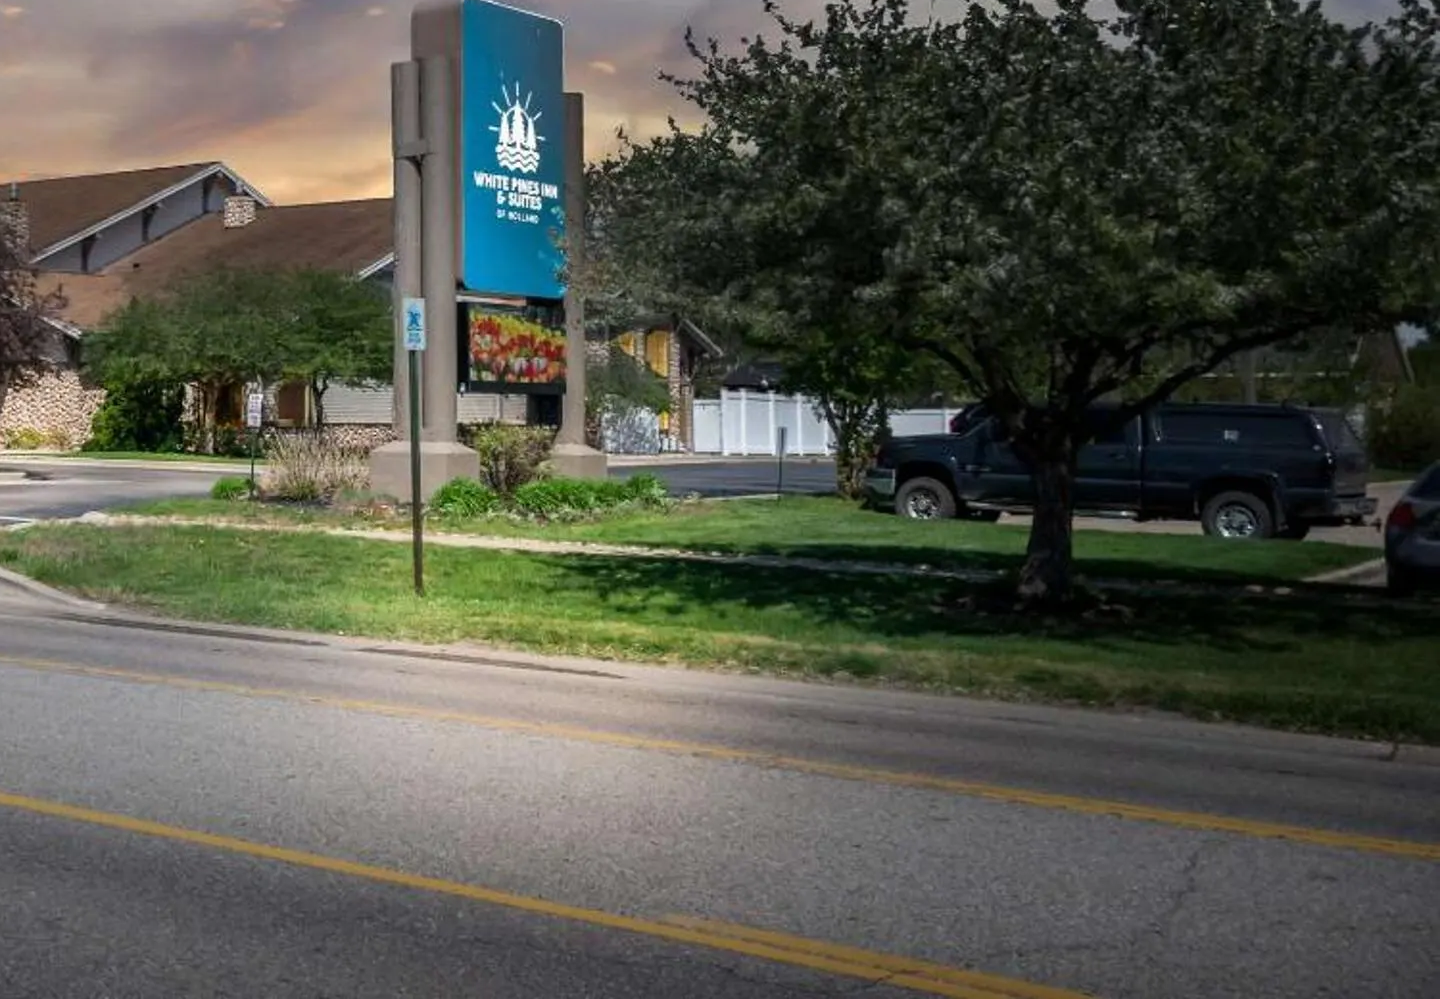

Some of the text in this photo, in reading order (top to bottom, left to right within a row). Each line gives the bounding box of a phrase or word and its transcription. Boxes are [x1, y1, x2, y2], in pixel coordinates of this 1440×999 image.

[474, 170, 558, 199] WHITE PINES INN
[496, 191, 542, 211] & SUITES
